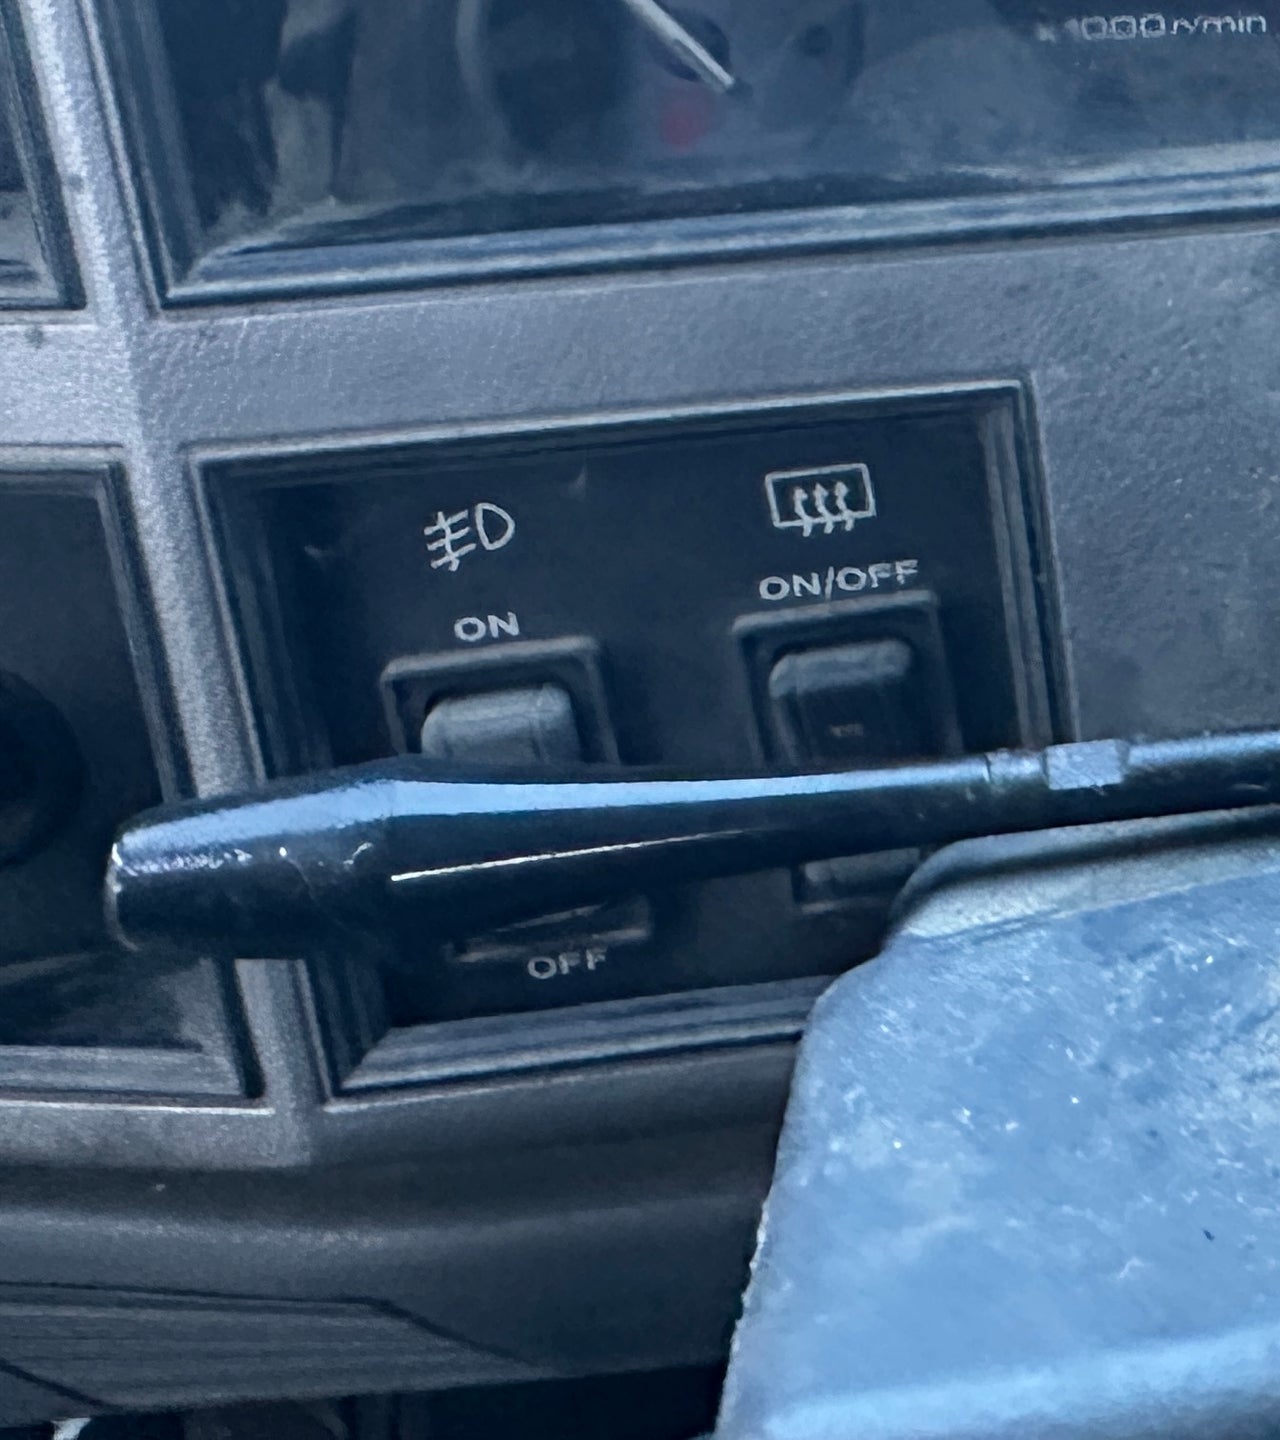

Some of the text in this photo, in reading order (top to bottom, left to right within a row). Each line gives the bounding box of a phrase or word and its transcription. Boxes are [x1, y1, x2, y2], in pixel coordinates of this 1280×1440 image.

[757, 559, 919, 602] ON/OFF
[453, 611, 521, 643] ON
[526, 948, 607, 981] OFF
